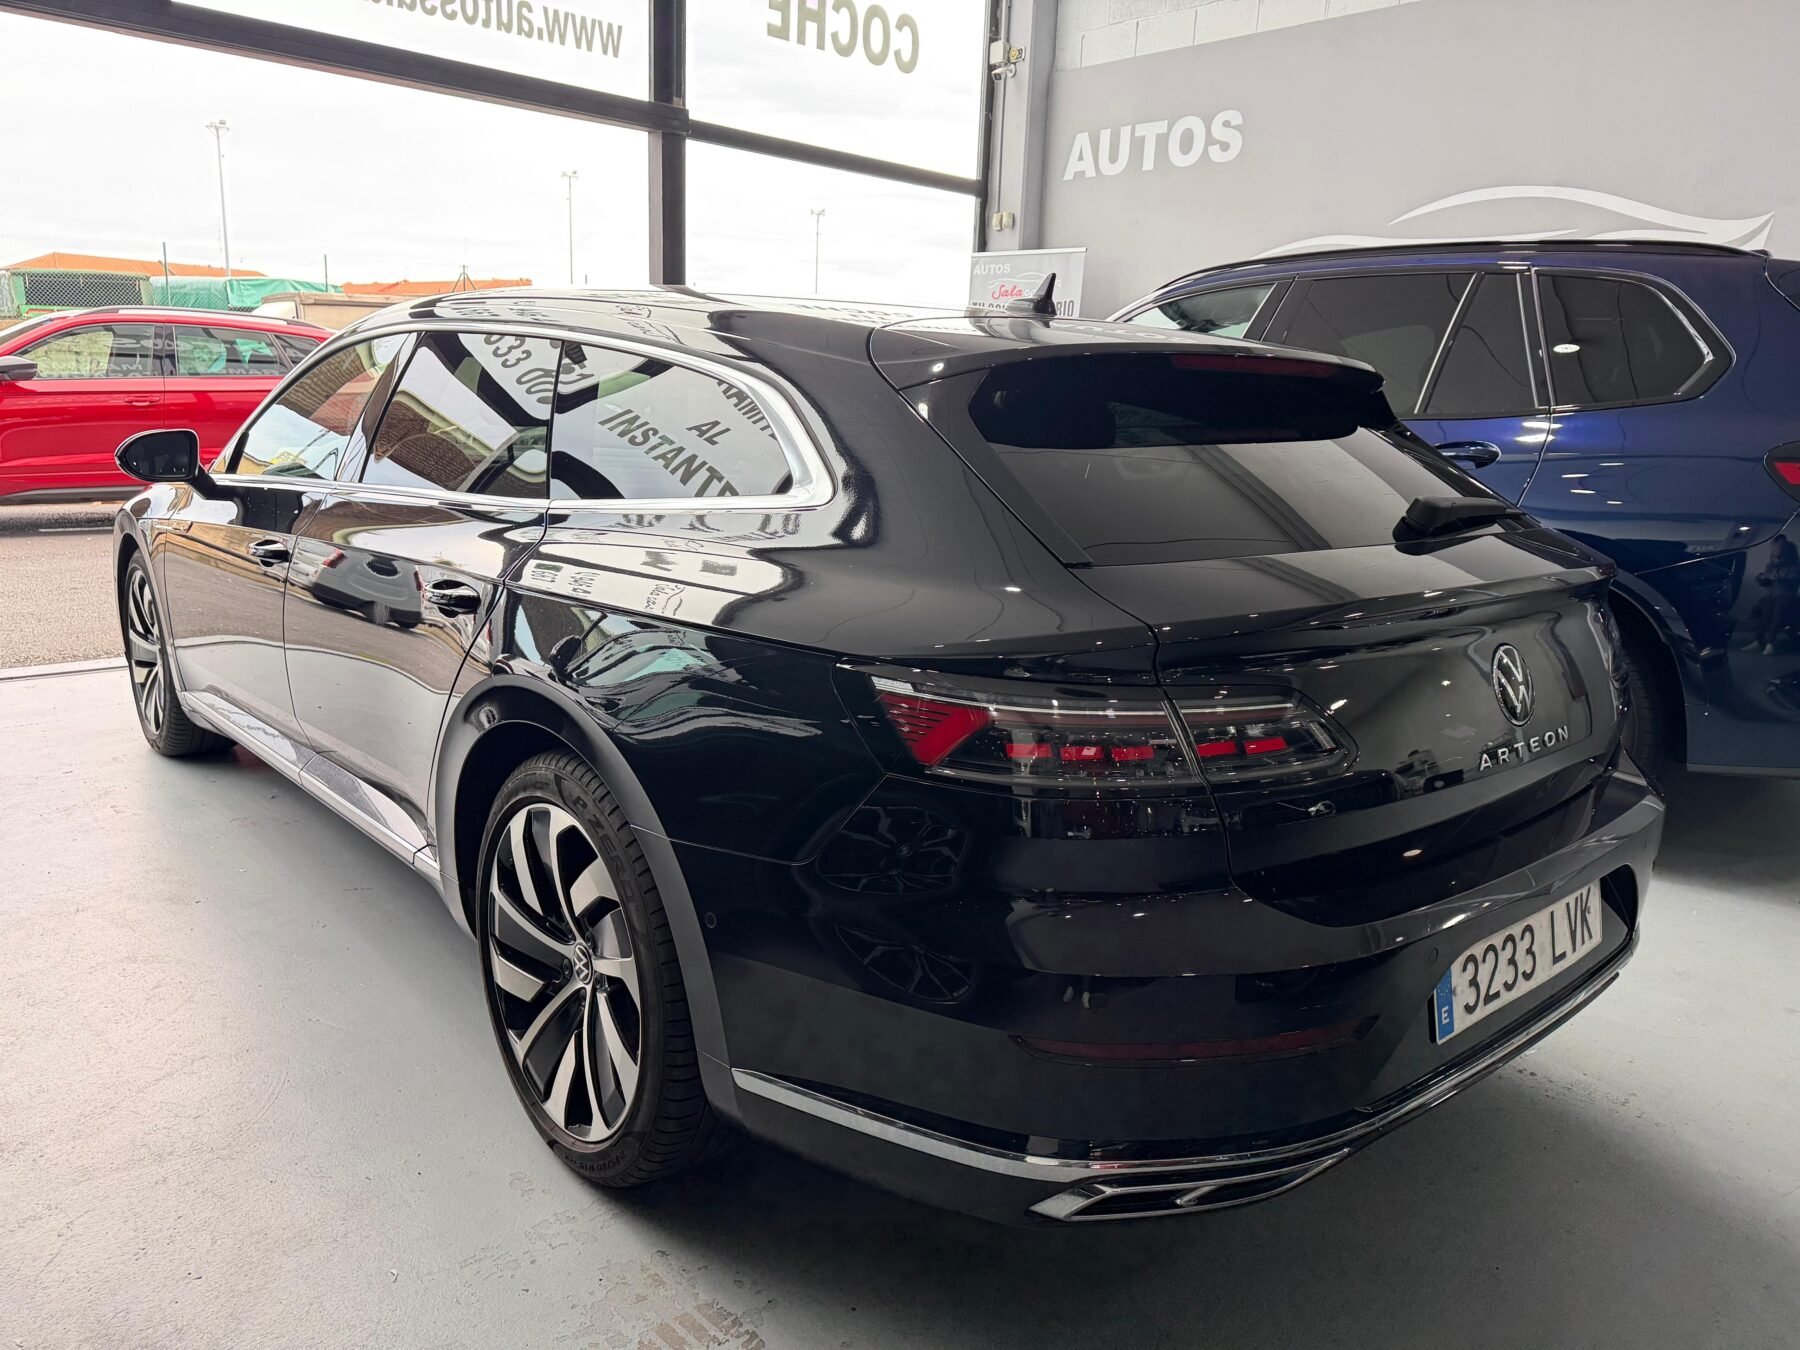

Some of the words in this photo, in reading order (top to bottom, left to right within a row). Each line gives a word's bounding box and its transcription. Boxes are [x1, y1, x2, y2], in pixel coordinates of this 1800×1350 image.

[1063, 110, 1243, 181] AUTOS
[973, 263, 1011, 275] AUTOS
[685, 420, 731, 446] AL
[1479, 725, 1569, 771] ARTEON
[1462, 923, 1537, 1015] 3233
[1550, 886, 1593, 966] LVK
[1441, 1005, 1450, 1024] E
